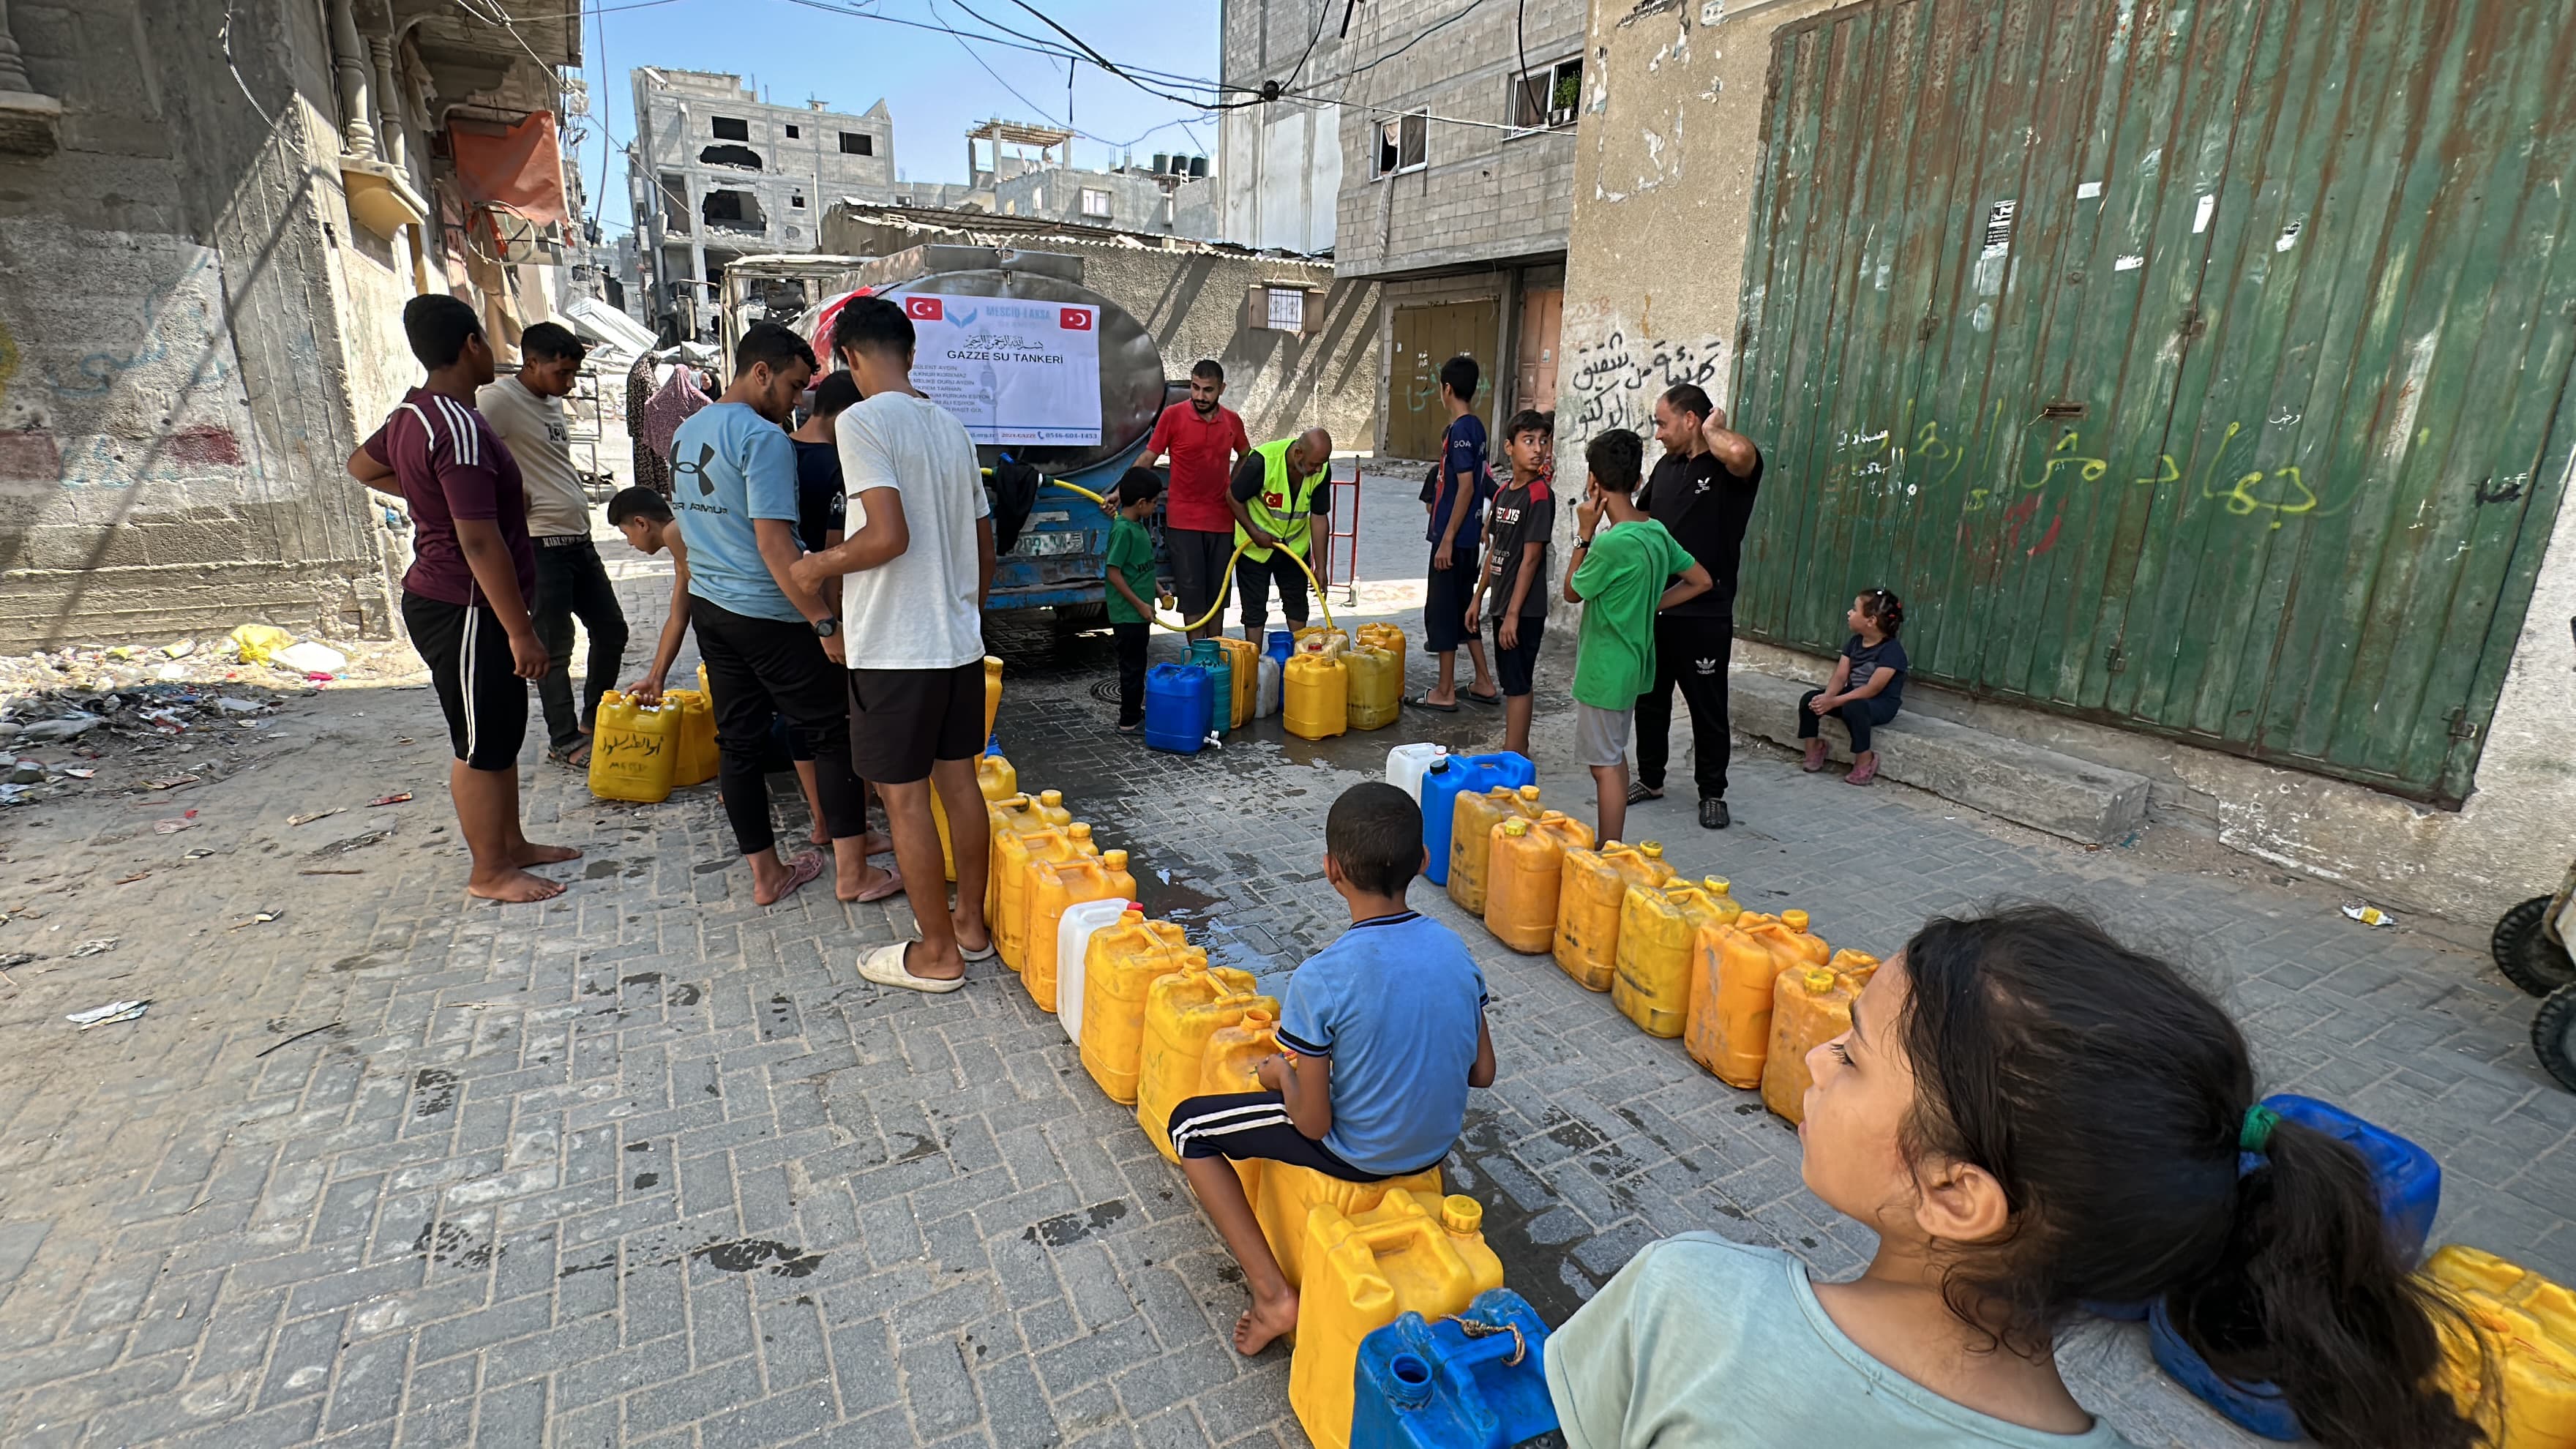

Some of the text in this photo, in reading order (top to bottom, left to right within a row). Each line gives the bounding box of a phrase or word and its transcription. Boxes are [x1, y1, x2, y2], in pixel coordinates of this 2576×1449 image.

[947, 350, 1063, 364] GAZZE SU TANKERİ
[690, 502, 728, 514] ARMOUR
